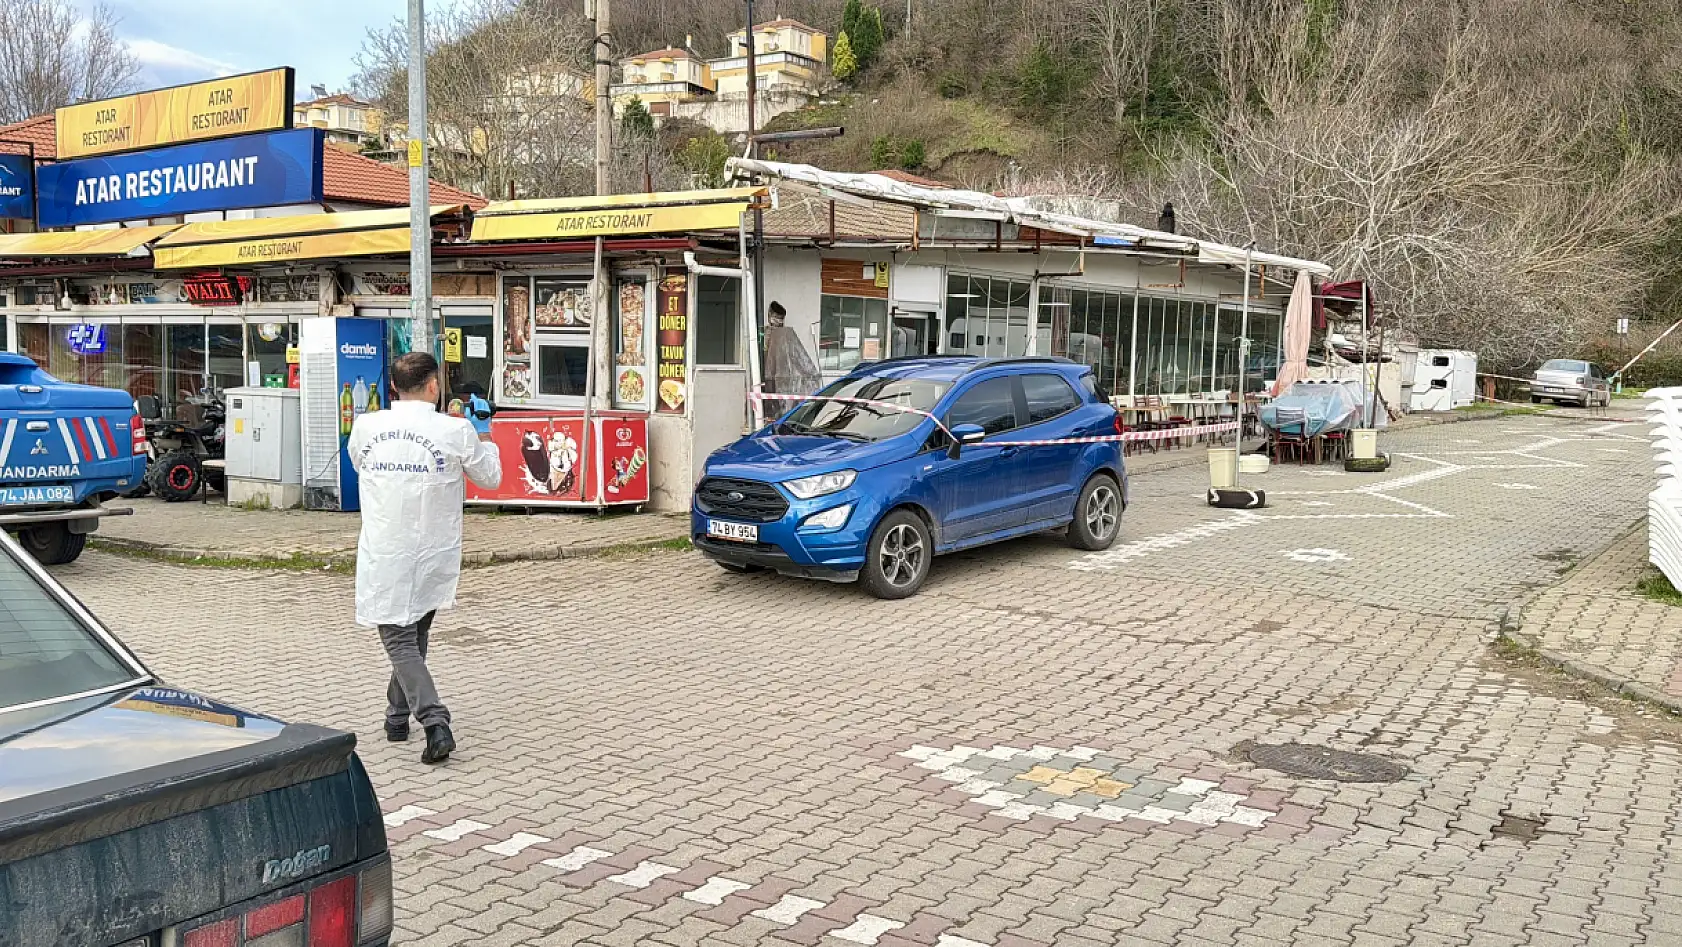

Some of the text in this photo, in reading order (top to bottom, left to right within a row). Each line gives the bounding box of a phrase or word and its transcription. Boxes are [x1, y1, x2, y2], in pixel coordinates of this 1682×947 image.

[208, 88, 233, 106] ATAR
[95, 108, 117, 125] ATAR
[192, 107, 249, 130] RESTORANT
[82, 126, 131, 146] RESTORANT
[75, 156, 258, 206] ATAR RESTAURANT
[556, 213, 653, 231] ATAR RESTORANT
[238, 241, 303, 258] ATAR RESTORANT
[668, 296, 679, 312] ET
[660, 312, 686, 331] DÖNER
[340, 342, 377, 356] damla
[661, 345, 685, 360] TAVUK
[660, 361, 685, 378] DÖNER
[0, 487, 71, 502] 74 JAA 082
[712, 521, 756, 538] 74 BY 954
